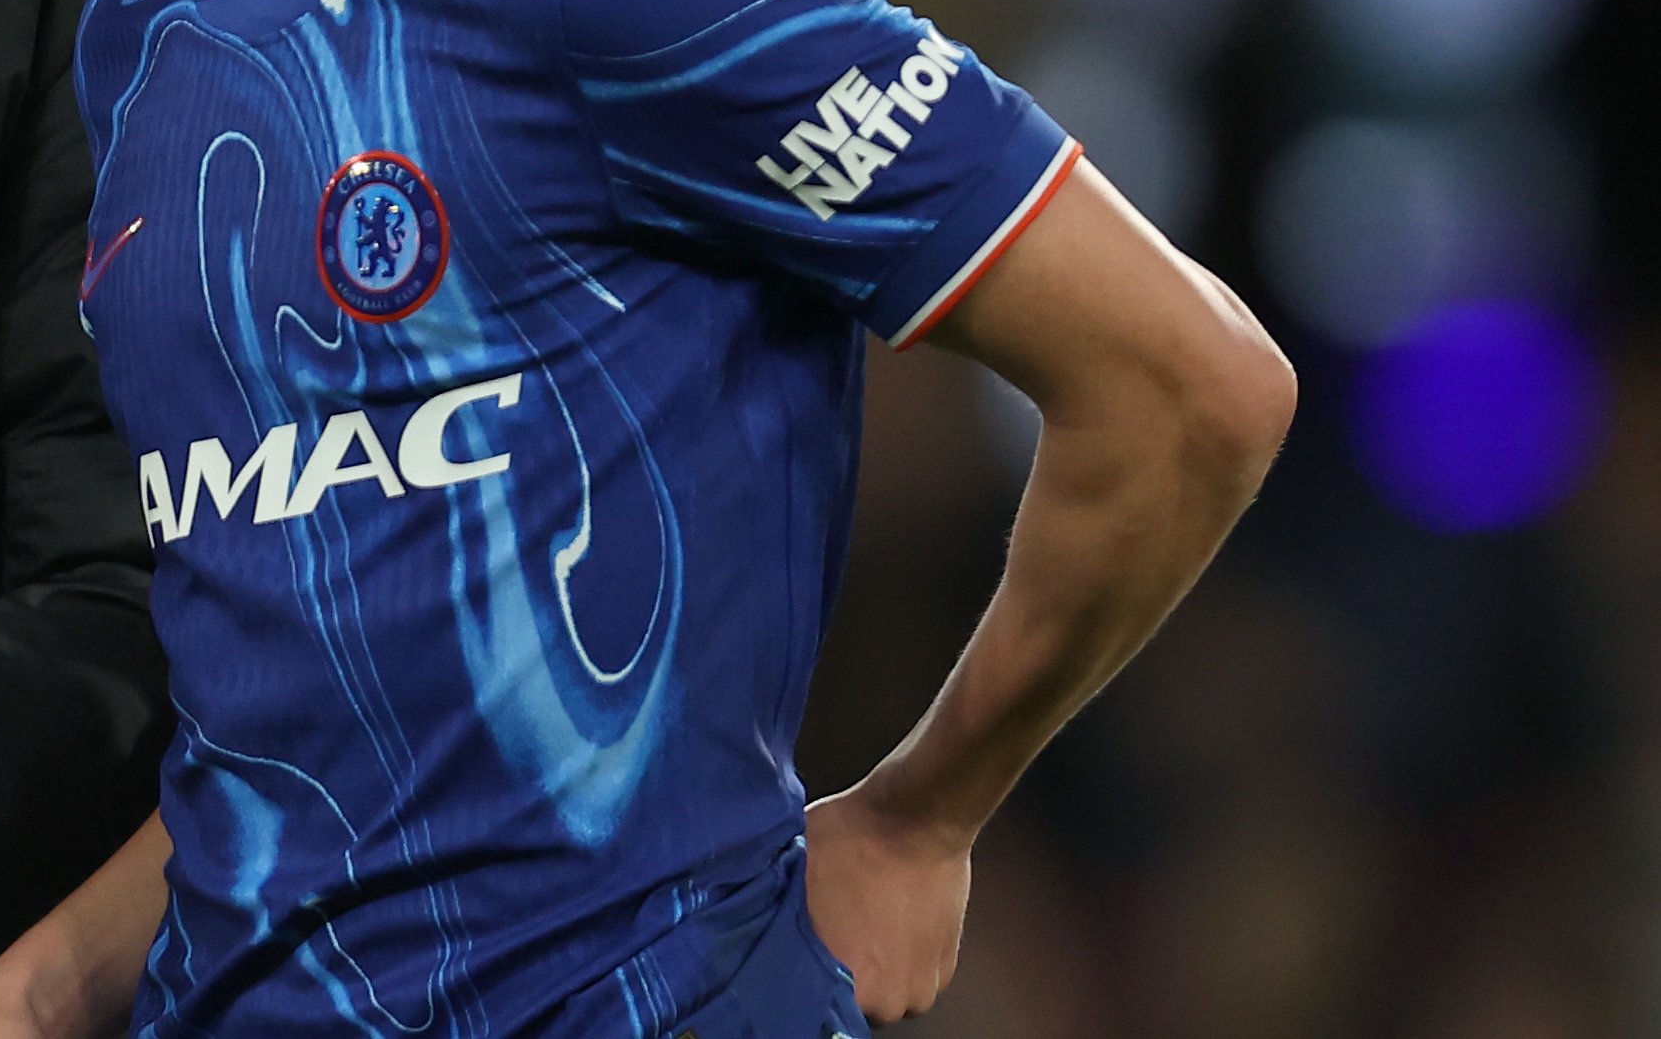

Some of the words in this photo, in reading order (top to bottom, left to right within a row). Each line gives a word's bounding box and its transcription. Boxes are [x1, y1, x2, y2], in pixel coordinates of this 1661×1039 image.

[755, 65, 885, 190] LIVE
[792, 24, 966, 222] NATION
[139, 372, 523, 550] AMAC
